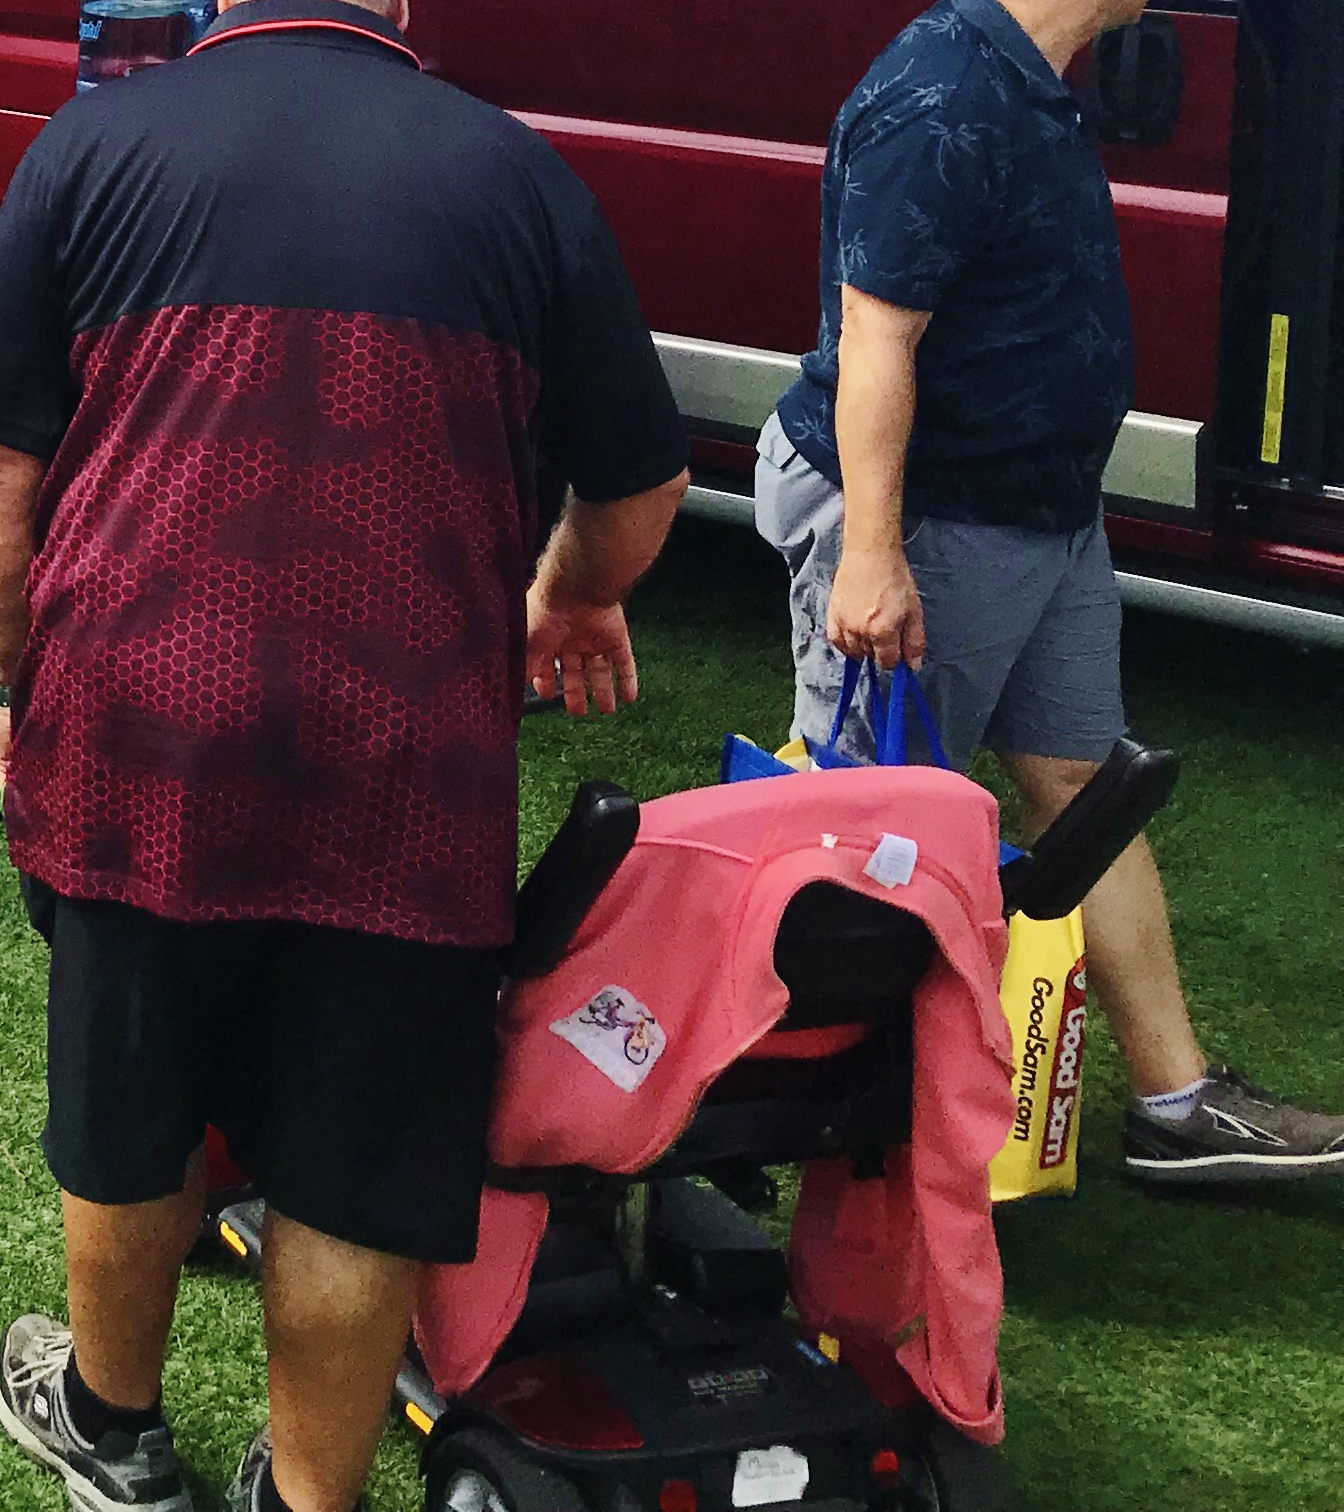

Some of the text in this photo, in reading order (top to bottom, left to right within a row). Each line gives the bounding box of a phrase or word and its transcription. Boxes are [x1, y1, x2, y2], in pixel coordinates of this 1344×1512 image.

[1013, 976, 1054, 1142] GoodSam.com
[1045, 1005, 1087, 1165] Good Sam
